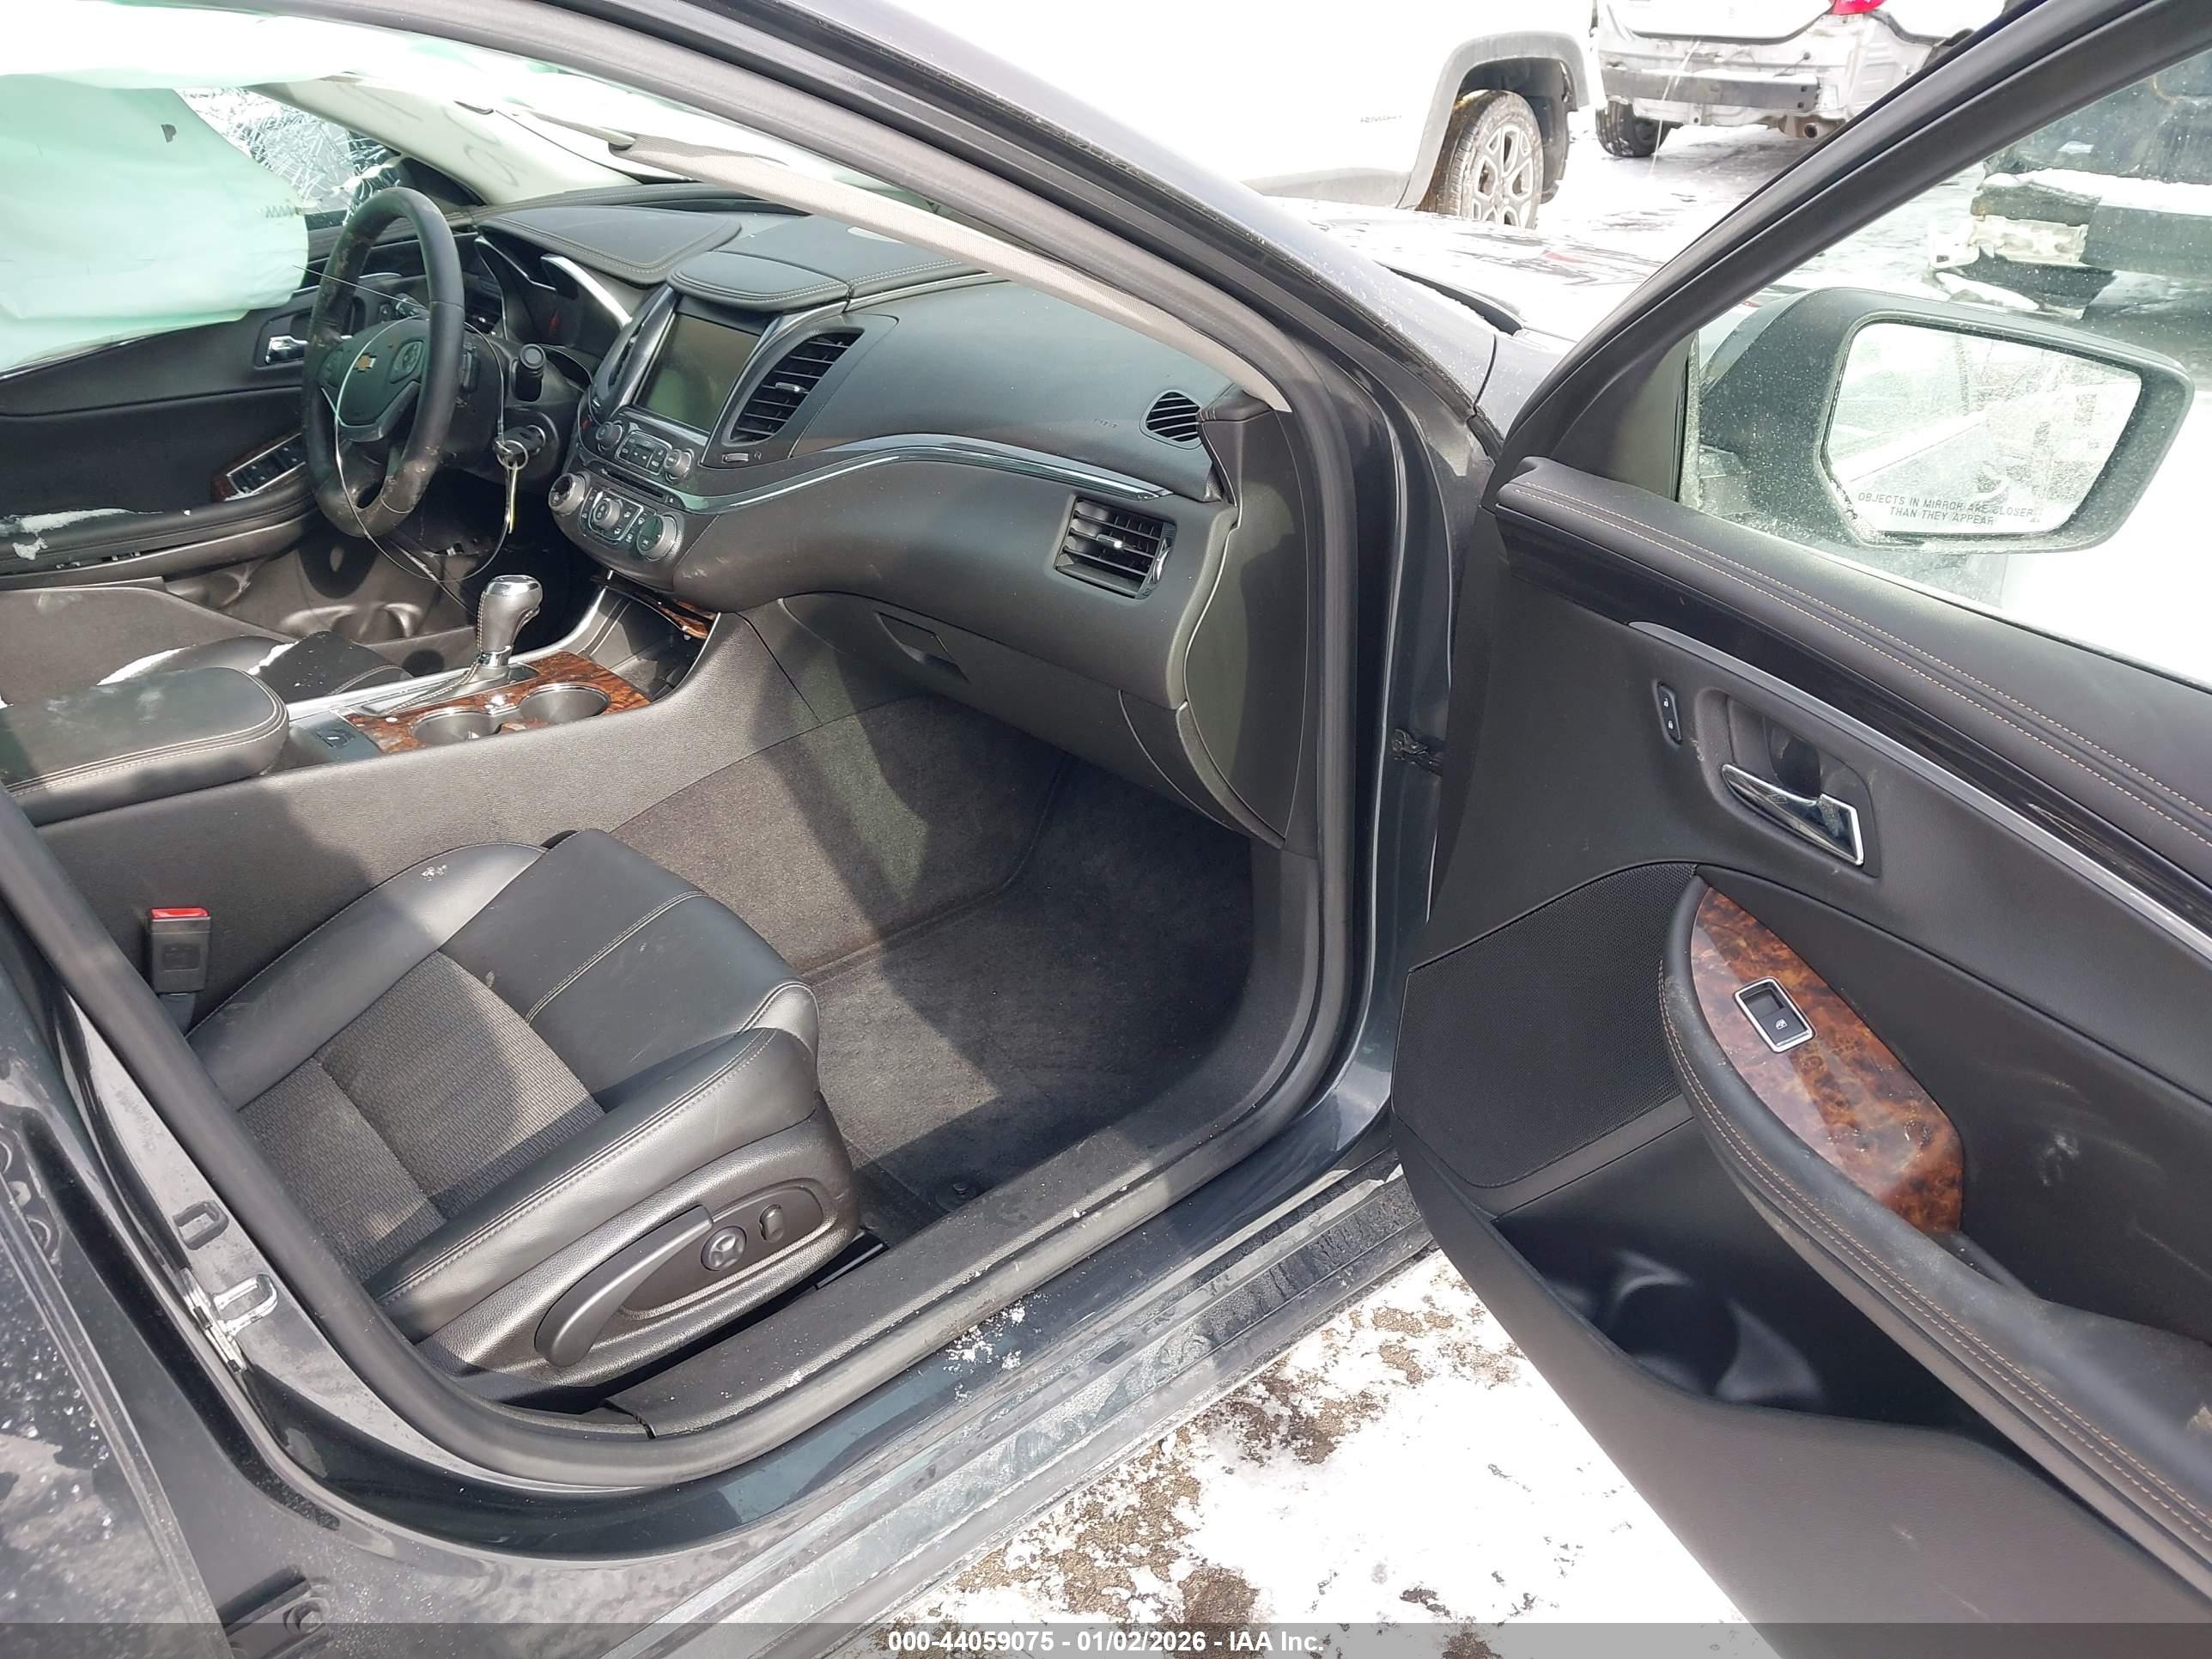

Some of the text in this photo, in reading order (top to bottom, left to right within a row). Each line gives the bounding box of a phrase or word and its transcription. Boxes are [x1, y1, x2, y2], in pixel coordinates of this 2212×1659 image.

[1857, 492, 2034, 517] OBJECTS IN MIRROR ARE CLOSER
[1890, 507, 1995, 526] THAN THEY APPEAR
